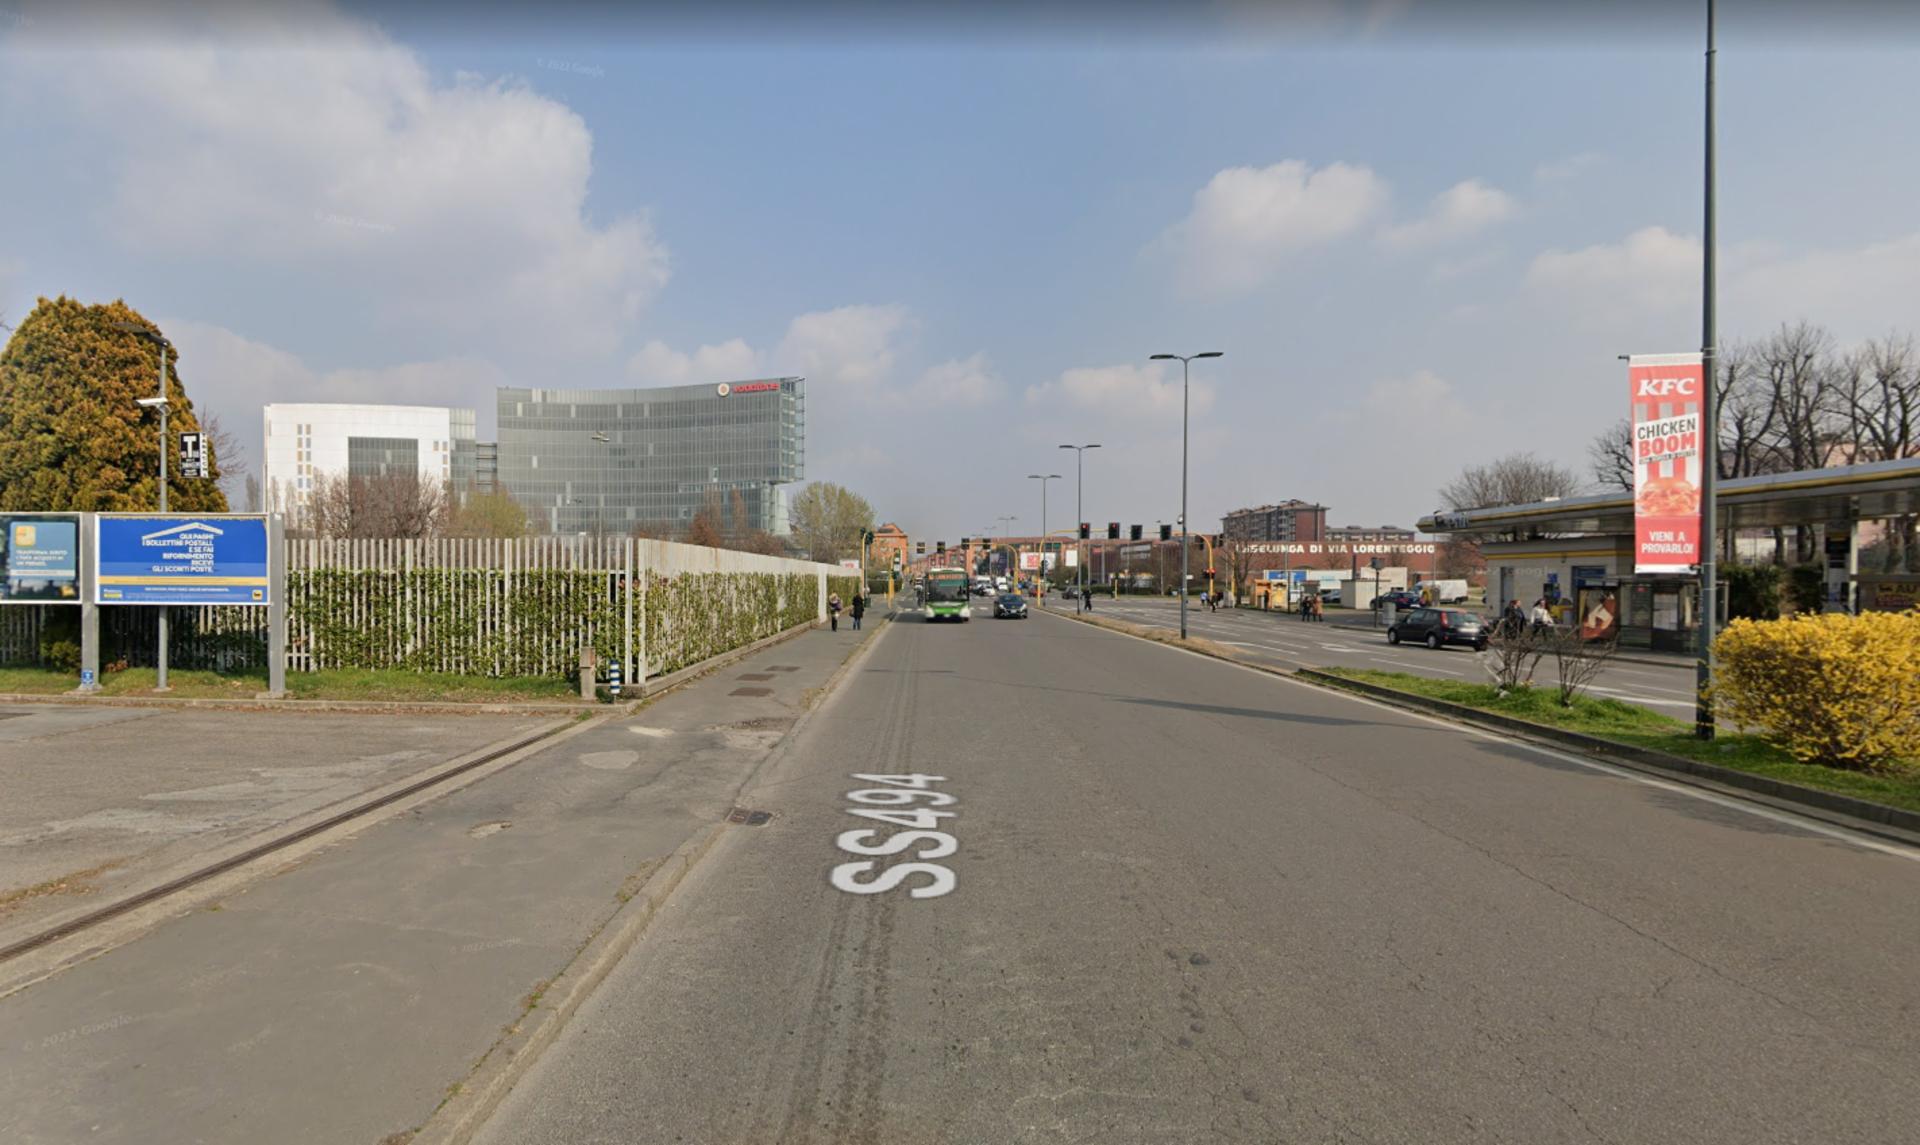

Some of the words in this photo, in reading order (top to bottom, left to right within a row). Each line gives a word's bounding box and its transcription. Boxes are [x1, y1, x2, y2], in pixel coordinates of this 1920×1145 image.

[1637, 378, 1696, 396] KFC
[1637, 418, 1696, 440] CHICKEN
[1638, 432, 1696, 457] BOOM
[1649, 531, 1674, 542] VIENI
[1678, 531, 1686, 541] A
[1309, 544, 1323, 553] DI
[1328, 544, 1348, 553] VIA
[1352, 544, 1436, 553] LORENTEGGIO
